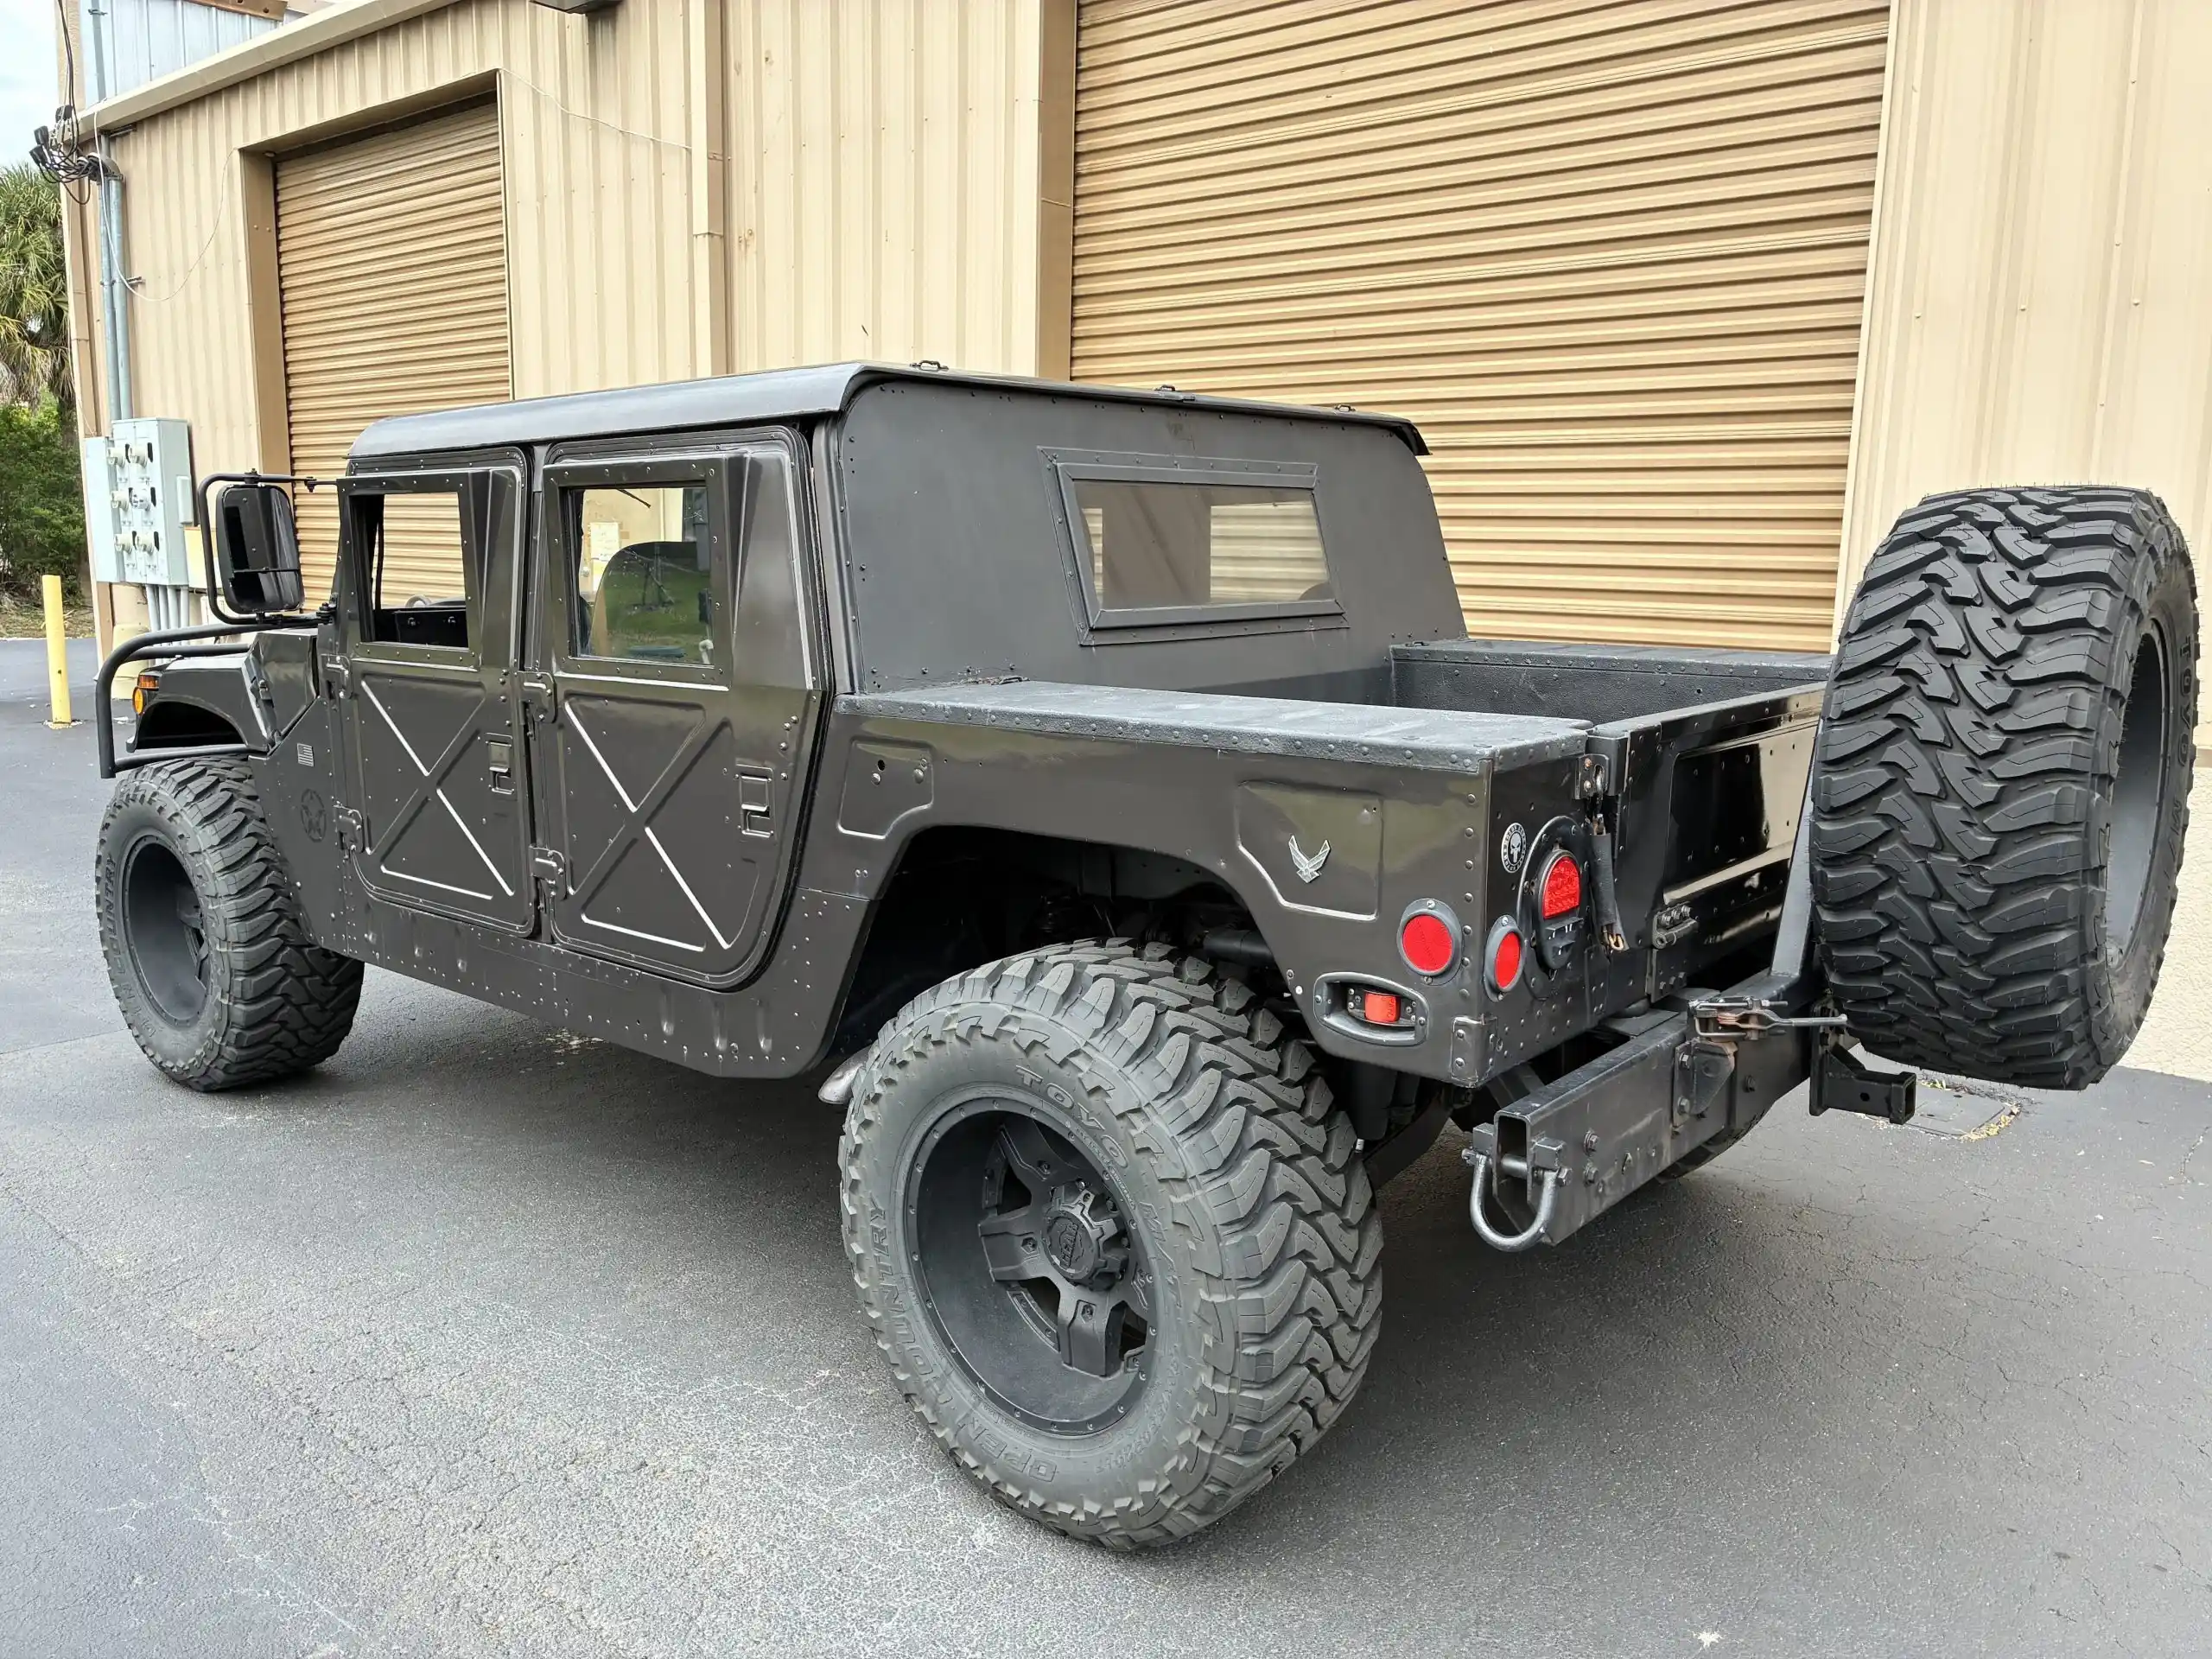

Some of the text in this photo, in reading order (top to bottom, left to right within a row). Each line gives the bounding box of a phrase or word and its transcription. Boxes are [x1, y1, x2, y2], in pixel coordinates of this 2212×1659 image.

[1016, 1065, 1129, 1168] TOYO
[870, 1198, 954, 1406] COUNTRY
[956, 1410, 1057, 1482] OPEN
